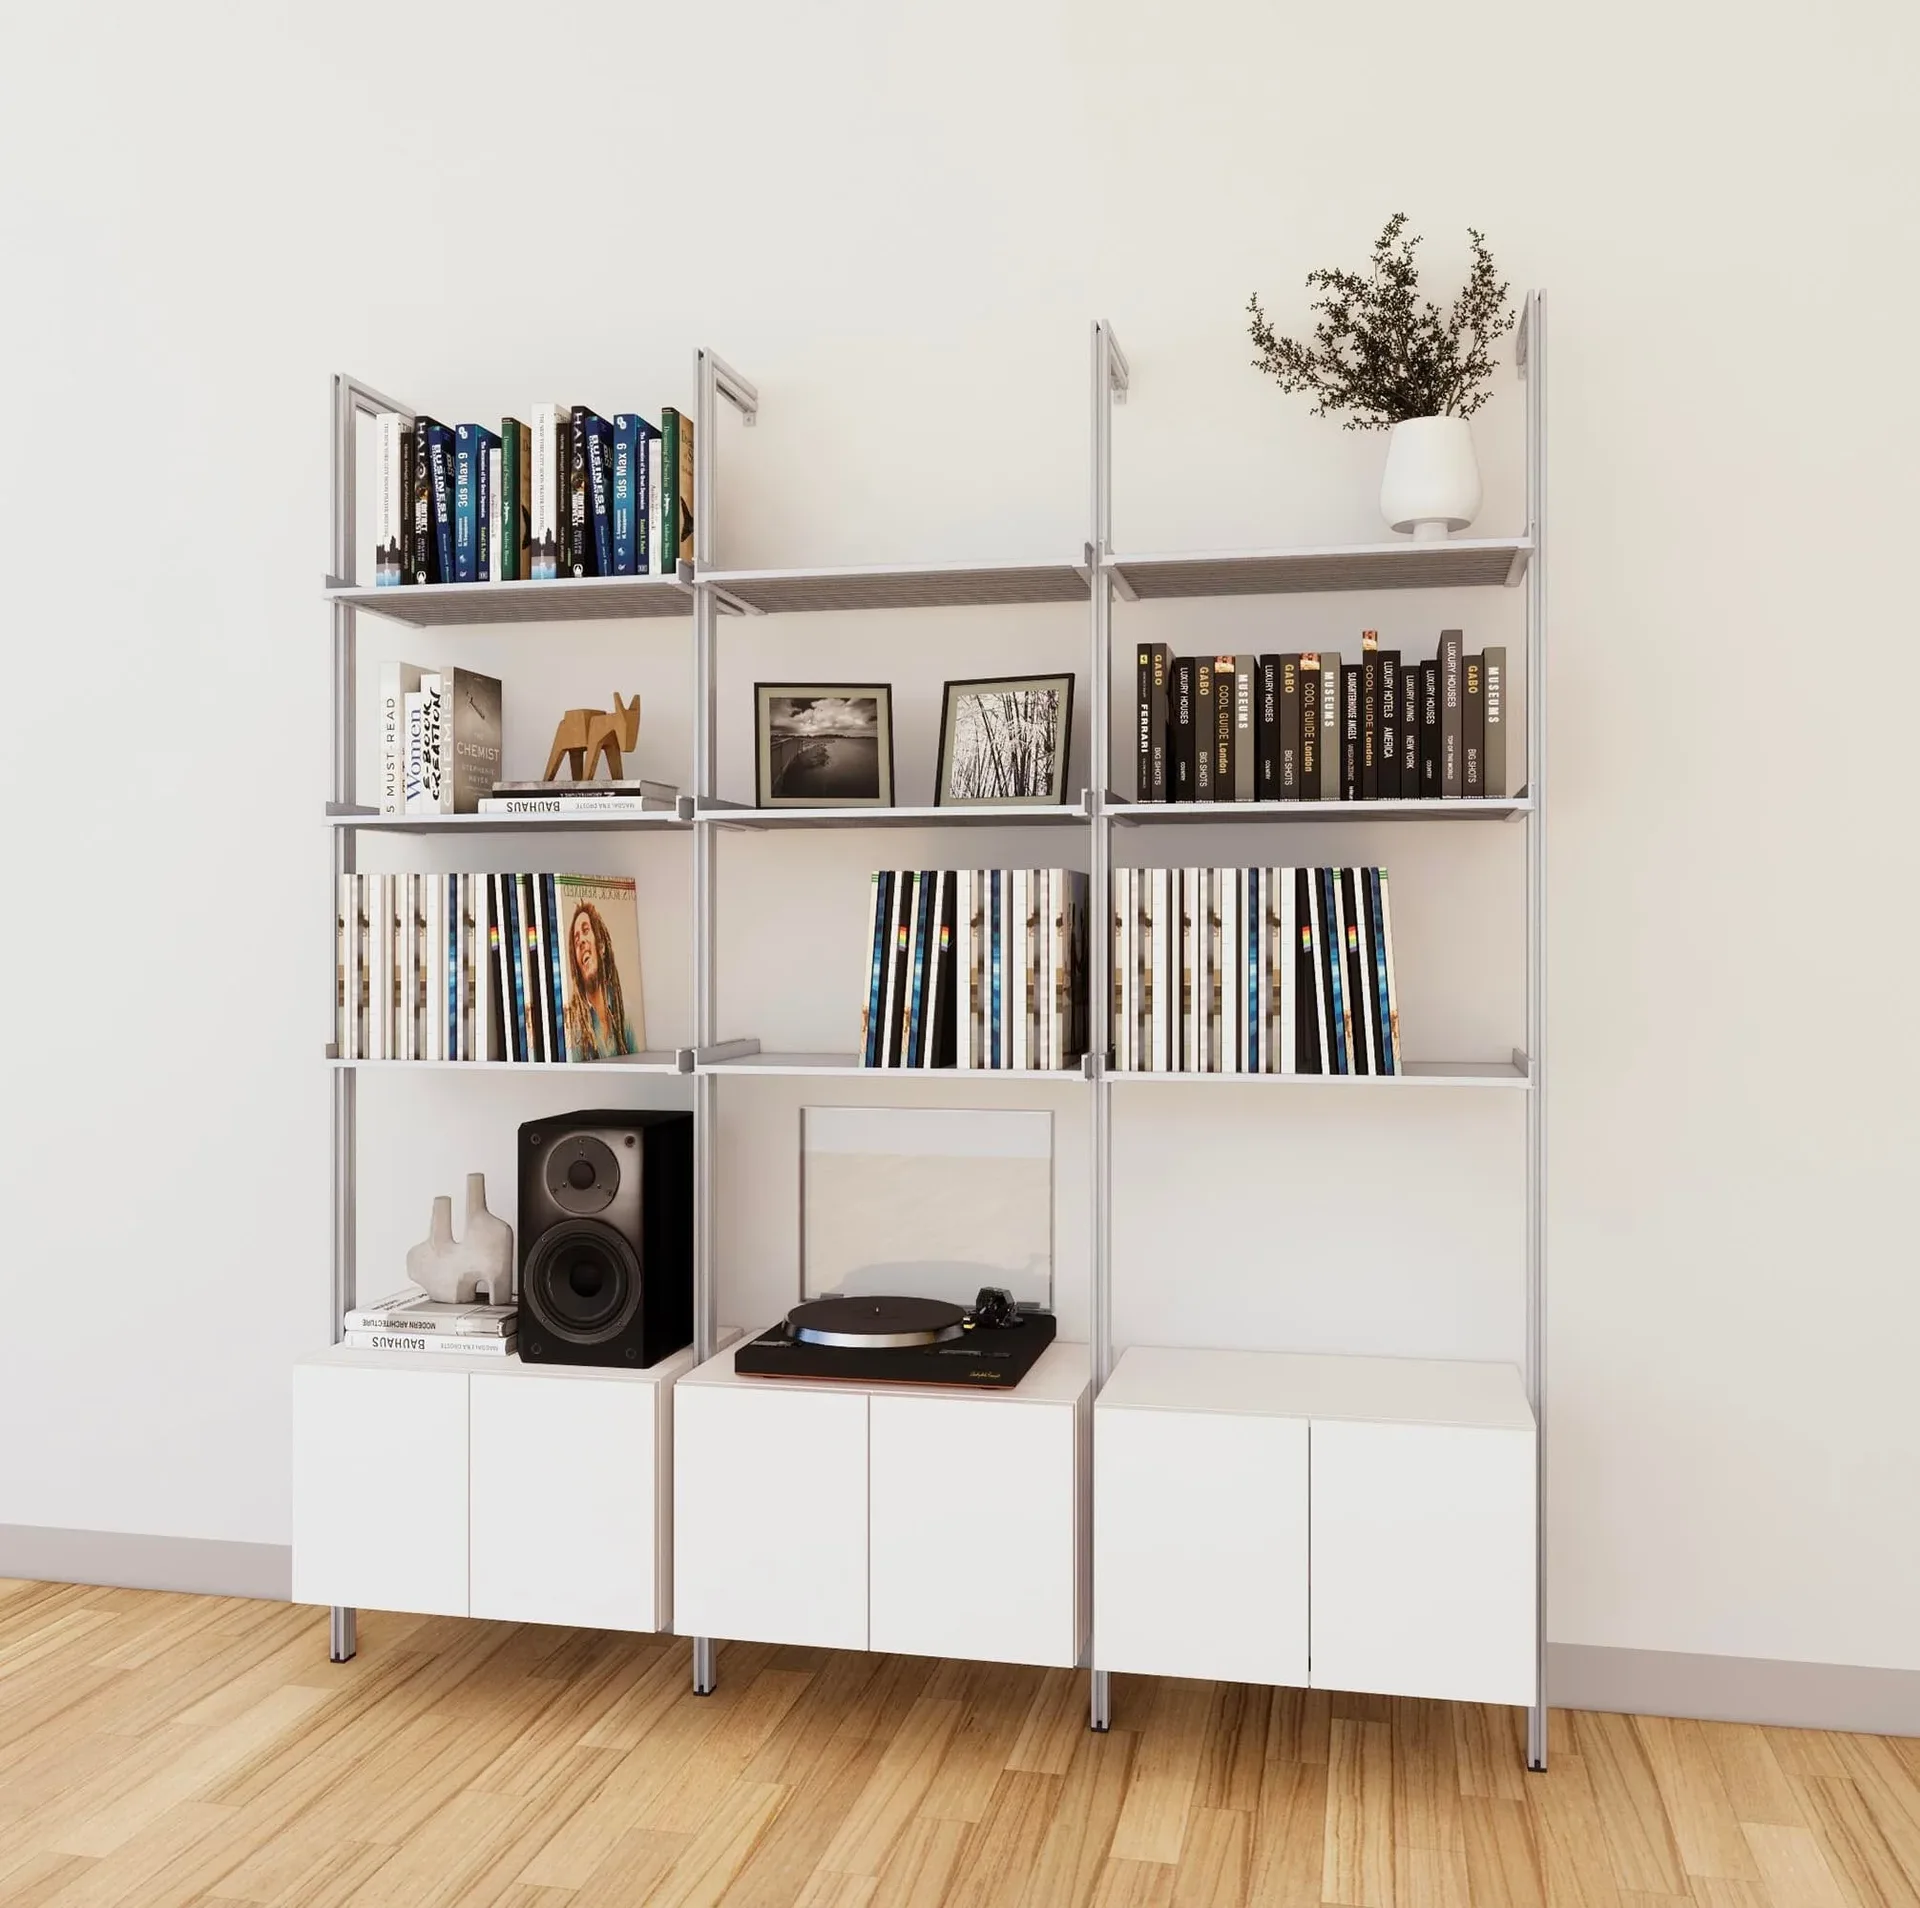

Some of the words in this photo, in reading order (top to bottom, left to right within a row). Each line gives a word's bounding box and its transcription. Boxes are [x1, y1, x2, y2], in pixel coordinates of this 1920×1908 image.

[417, 422, 426, 479] HALO
[574, 412, 583, 470] HALO
[617, 442, 627, 450] 9
[458, 462, 468, 485] Max
[592, 434, 605, 515] BUSINESS
[617, 452, 627, 476] Max
[434, 444, 447, 522] BUSINESS
[617, 479, 627, 498] 3ds
[458, 488, 468, 508] 3ds
[1447, 642, 1456, 673] LUXURY
[1180, 668, 1188, 694] LUXURY
[1199, 666, 1209, 696] GABO
[1265, 665, 1273, 691] LUXURY
[1284, 664, 1294, 693] GABO
[1366, 665, 1374, 693] COOL
[1384, 661, 1393, 689] LUXURY
[1406, 675, 1414, 701] LUXURY
[1426, 670, 1435, 696] LUXURY
[1468, 666, 1478, 694] GABO
[1219, 686, 1228, 709] COOL
[1238, 674, 1248, 729] MUSEUMS
[1304, 683, 1314, 708] COOL
[1324, 672, 1334, 727] MUSEUMS
[1348, 672, 1357, 718] SLAUGHTERHOUSE
[1384, 690, 1393, 718] HOTELS
[1447, 674, 1456, 707] HOUSES
[1488, 666, 1499, 723] MUSEUMS
[1180, 695, 1188, 725] HOUSES
[1265, 692, 1273, 723] HOUSES
[1366, 696, 1374, 728] GUIDE
[1406, 702, 1414, 722] LIVING
[1426, 697, 1435, 724] HOUSES
[1219, 711, 1228, 739] GUIDE
[1304, 710, 1314, 738] GUIDE
[1348, 720, 1357, 740] ANGELS
[406, 709, 421, 801] Women
[422, 700, 432, 790] E-BOOK
[430, 686, 441, 801] CREATION
[443, 676, 452, 807] CHEMIST
[456, 742, 500, 762] CHEMIST
[1366, 731, 1374, 767] London
[1384, 727, 1393, 758] AMERICA
[1406, 735, 1414, 750] NEW
[1468, 749, 1476, 760] BIG
[1199, 752, 1207, 763] BIG
[1219, 742, 1228, 774] London
[1284, 750, 1292, 762] BIG
[1304, 741, 1314, 772] London
[1406, 751, 1414, 769] YORK
[1199, 764, 1207, 787] SHOTS
[1284, 763, 1292, 786] SHOTS
[1468, 761, 1476, 783] SHOTS
[506, 801, 560, 813] BAUHAUS
[362, 1319, 408, 1328] ARCHITECTURE
[409, 1321, 436, 1330] MODERN
[372, 1336, 425, 1350] BAUHAUS
